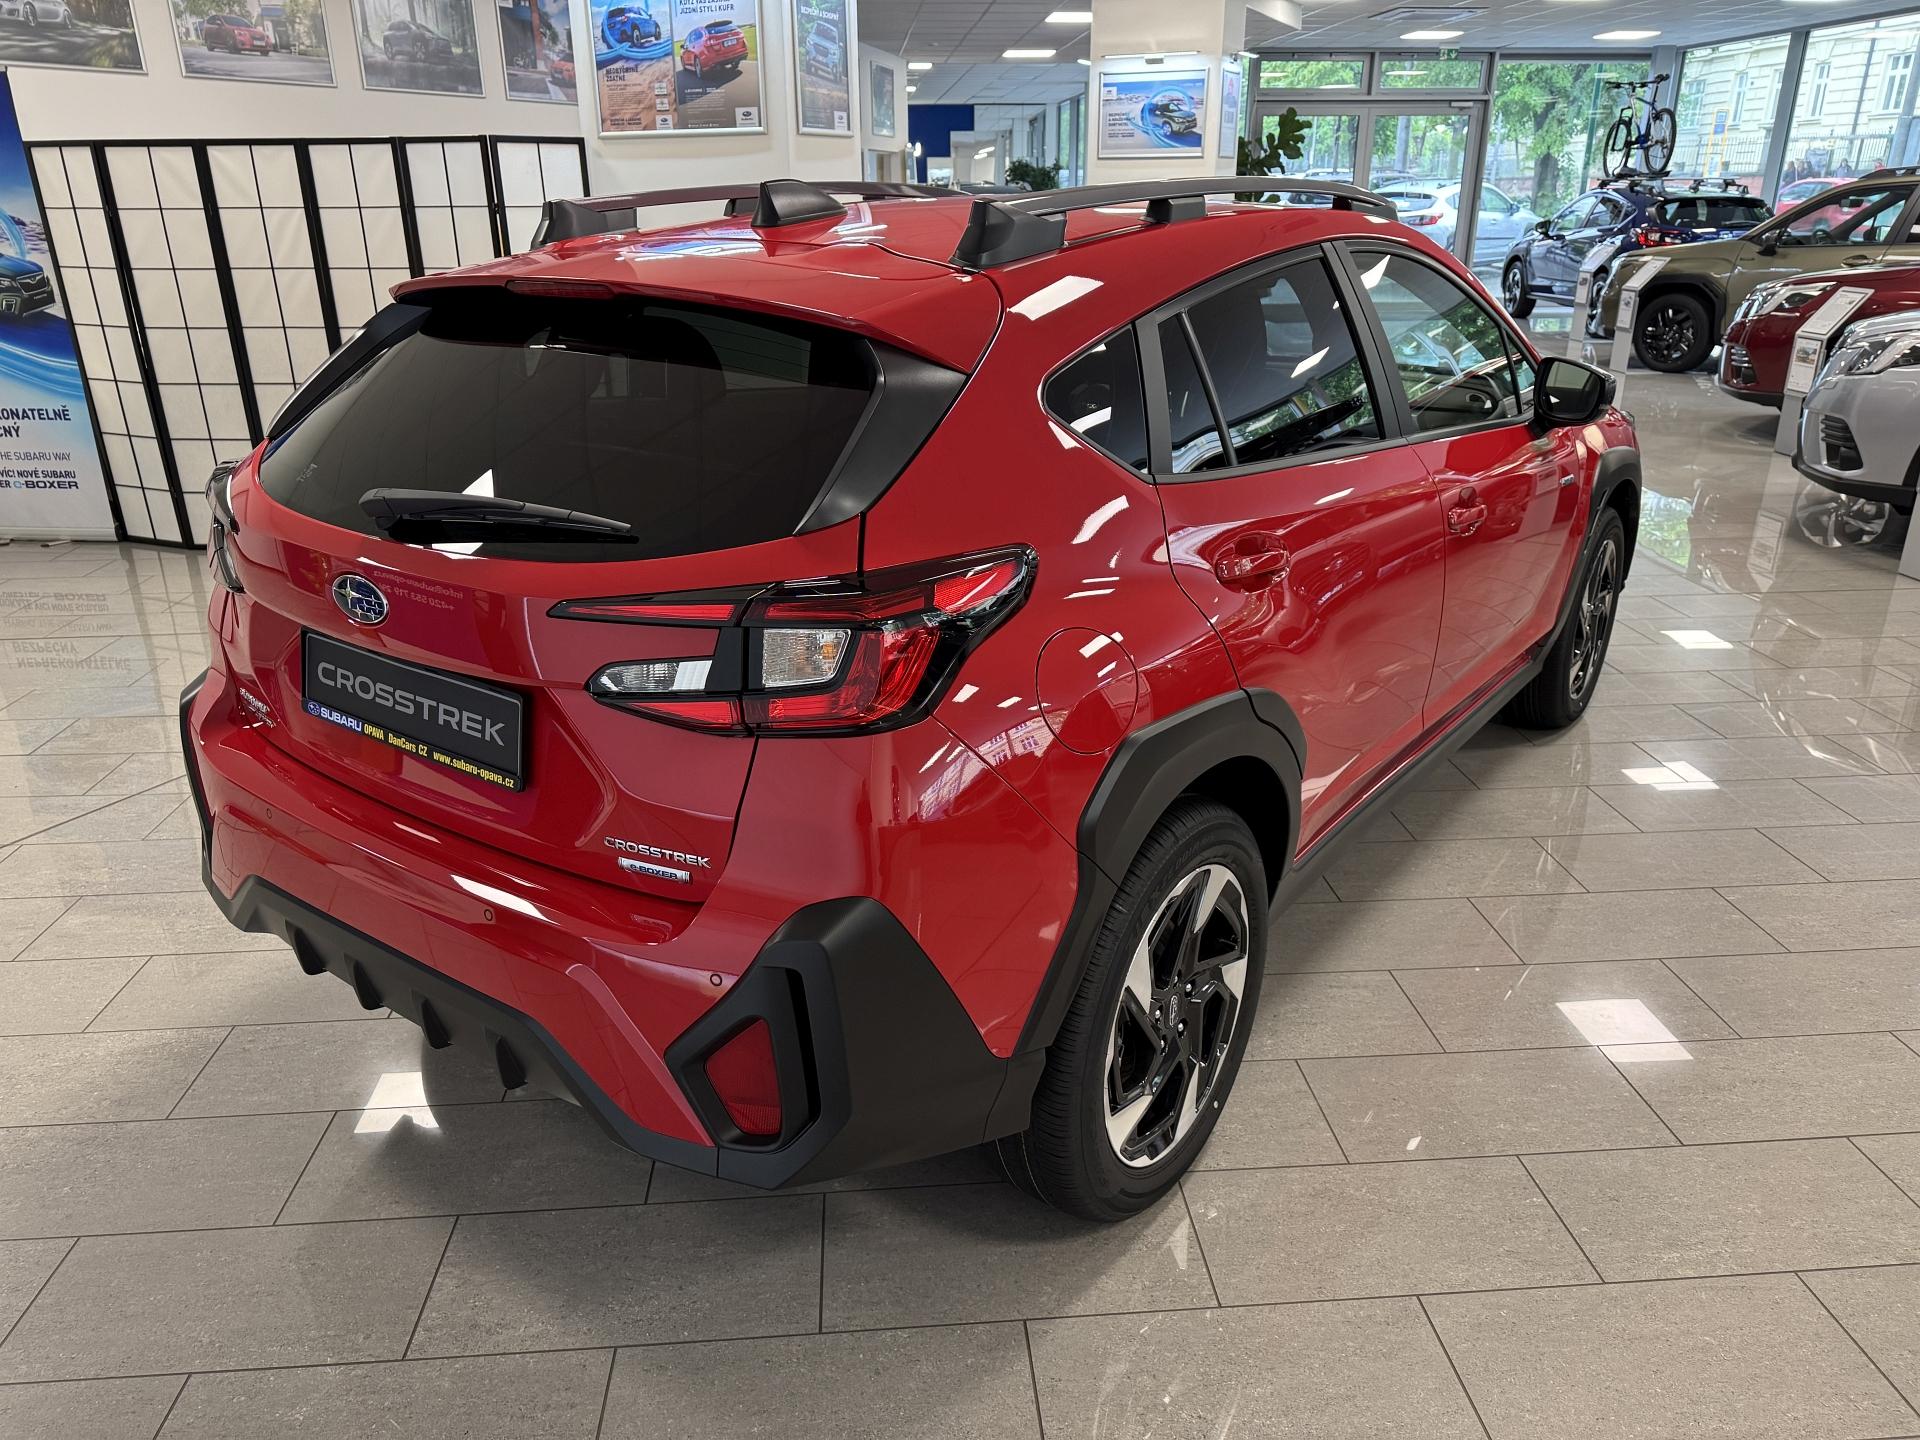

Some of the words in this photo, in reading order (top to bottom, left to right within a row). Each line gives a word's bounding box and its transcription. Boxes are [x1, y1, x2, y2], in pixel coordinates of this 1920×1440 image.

[699, 5, 714, 13] STYL
[0, 405, 71, 421] ONATELNĚ
[0, 452, 12, 461] HE
[14, 452, 51, 461] SUBARU
[52, 452, 71, 461] WAY
[17, 467, 40, 478] NOVÉ
[41, 470, 76, 479] SUBARU
[317, 661, 505, 748] CROSSTREK
[320, 707, 362, 732] SUBARU
[364, 723, 385, 741] OPAVA
[388, 732, 416, 753] DanCars
[418, 744, 428, 757] CZ
[433, 751, 515, 788] www.subaru-opava.cz
[603, 836, 712, 869] CROSSTREK
[629, 863, 678, 879] e-BOXER
